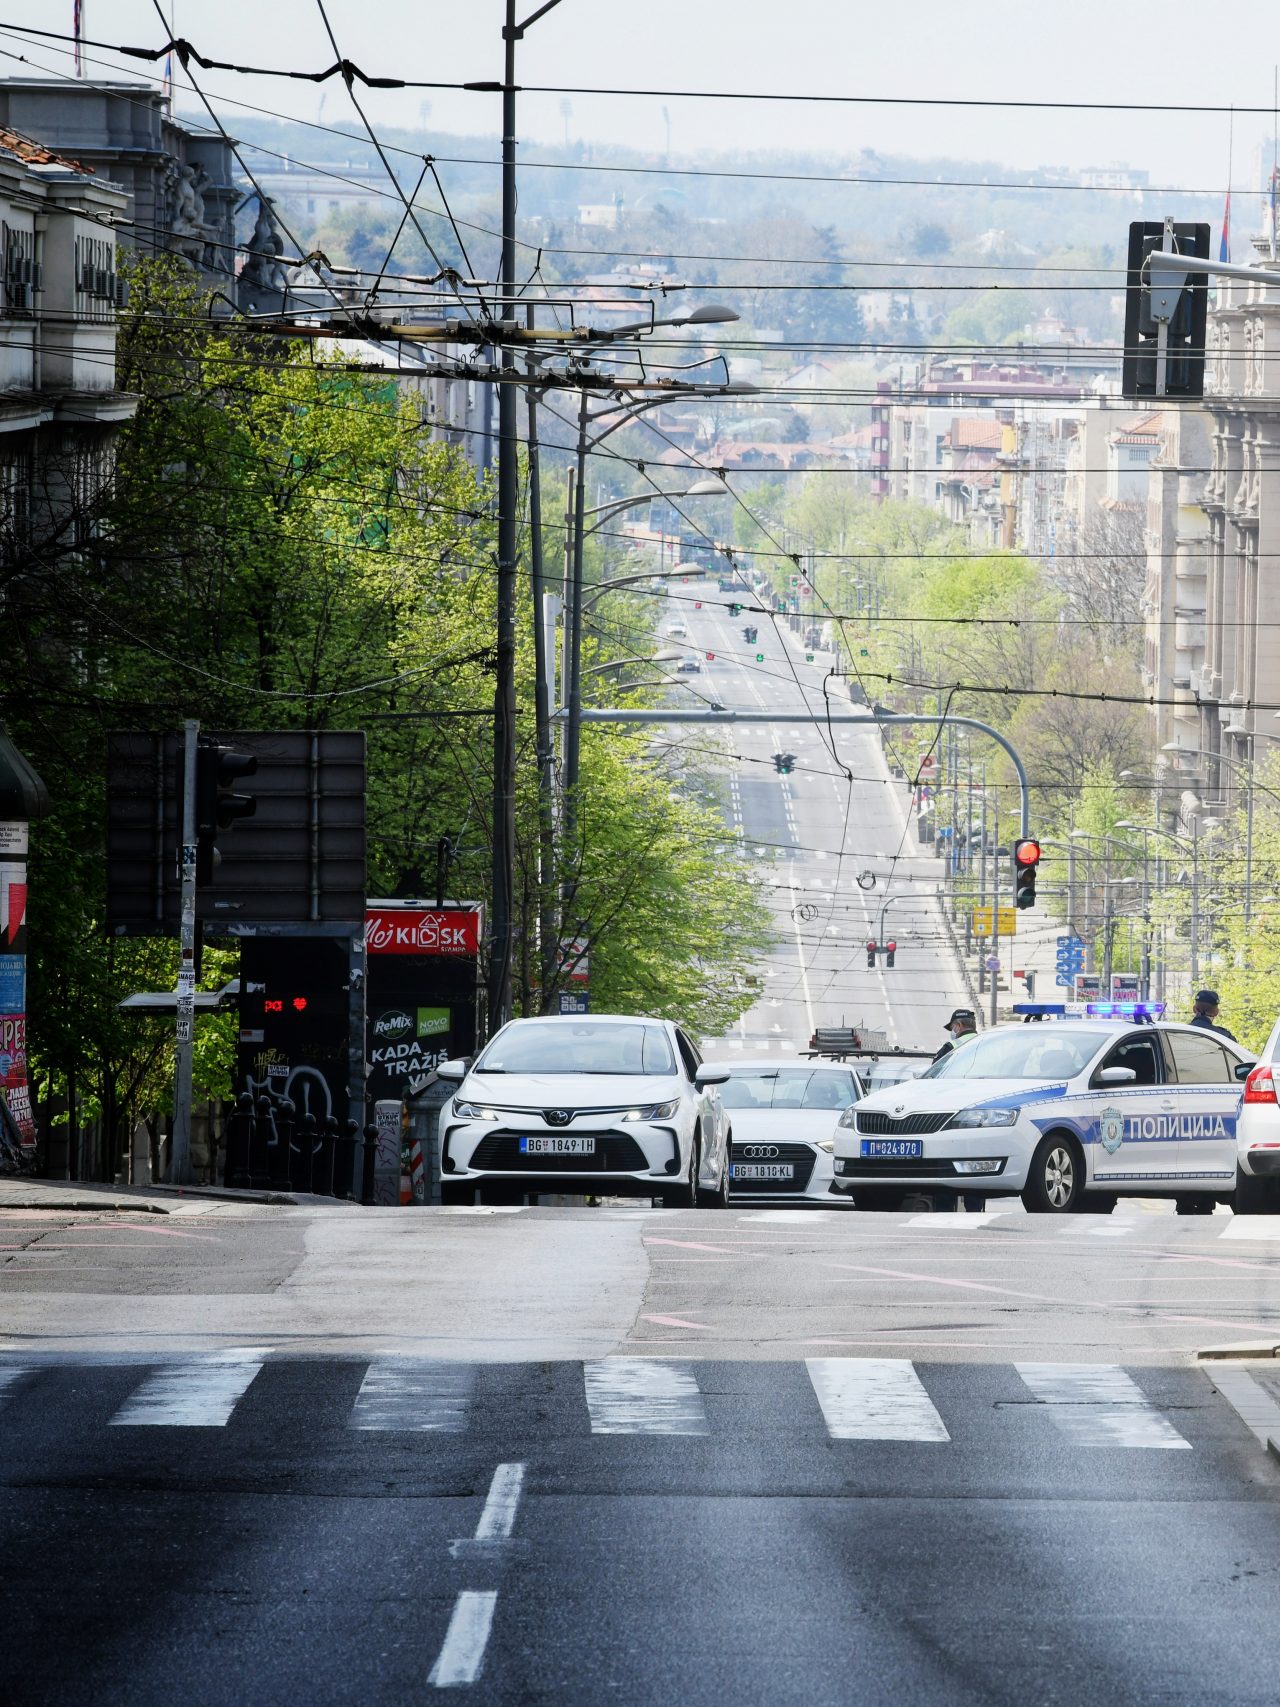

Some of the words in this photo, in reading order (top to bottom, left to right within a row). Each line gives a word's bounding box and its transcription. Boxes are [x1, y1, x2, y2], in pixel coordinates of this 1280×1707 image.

[364, 919, 394, 949] Moj
[374, 1016, 413, 1034] ReMix
[420, 1017, 448, 1029] NOVO
[371, 1041, 422, 1063] KADA
[384, 1048, 449, 1077] TRAŽIŠ
[1129, 1114, 1226, 1140] ПОЛИЦИЈА
[528, 1139, 541, 1152] BG
[870, 1142, 876, 1155] П
[734, 1166, 746, 1177] BG
